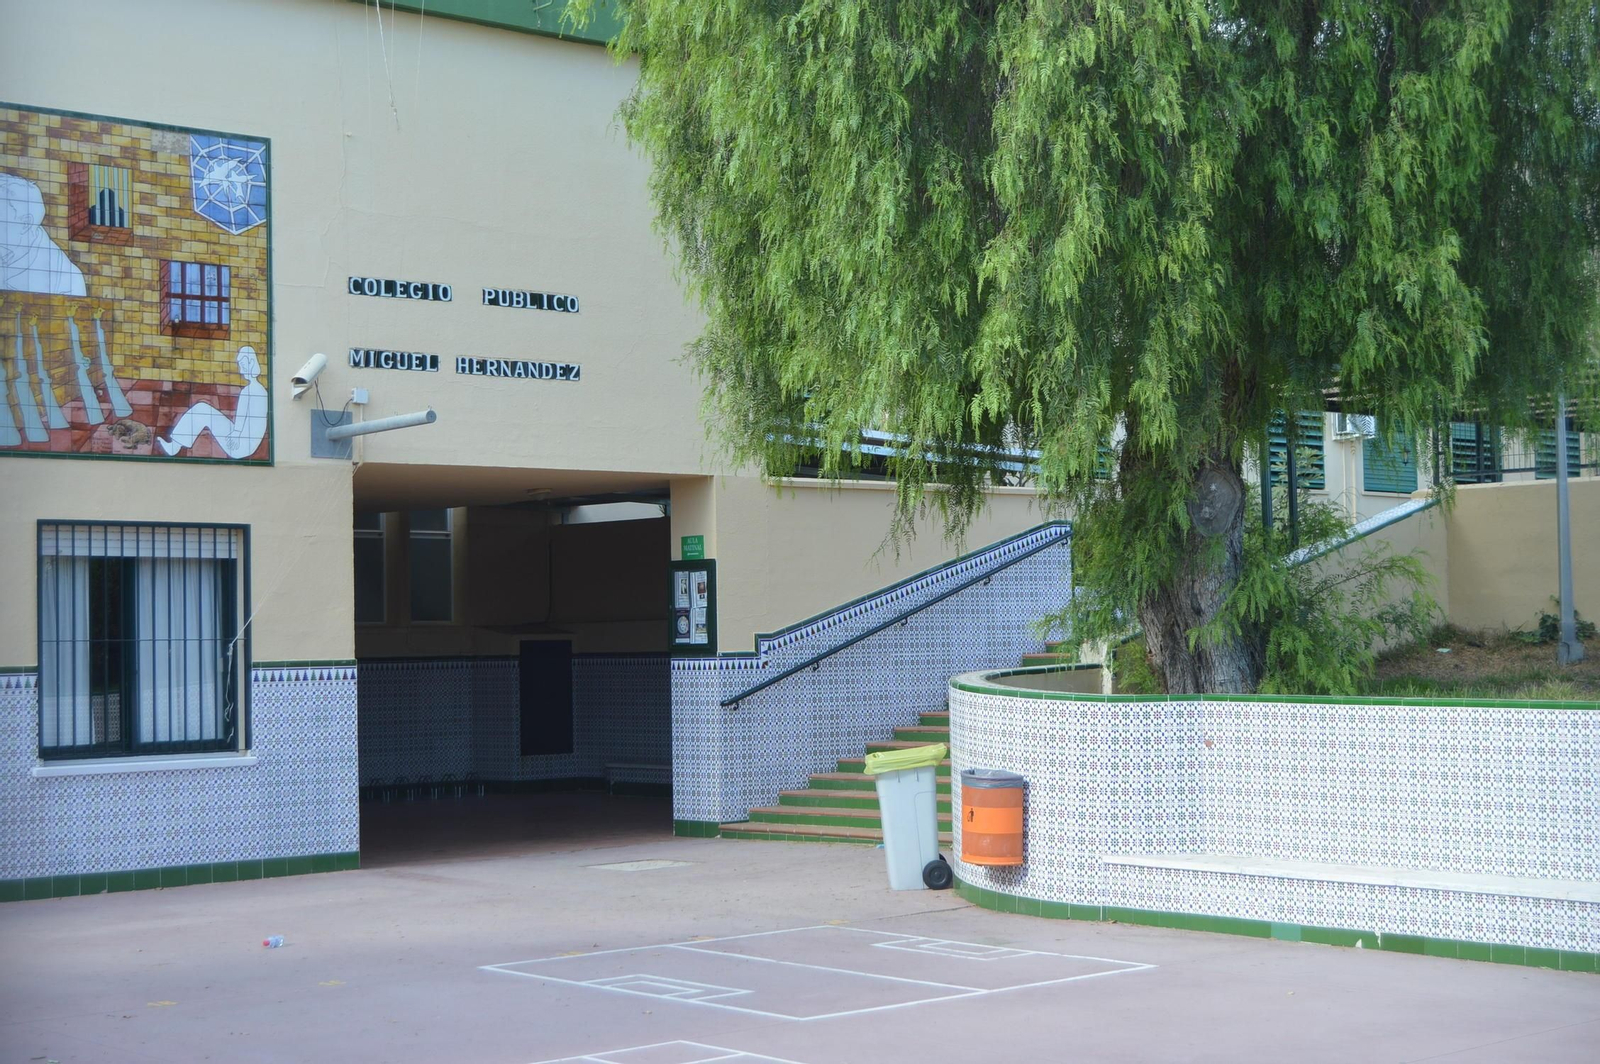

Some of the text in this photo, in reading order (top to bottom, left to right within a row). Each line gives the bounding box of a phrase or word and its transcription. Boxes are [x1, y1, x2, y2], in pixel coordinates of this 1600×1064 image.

[349, 277, 579, 313] COLEGIO PUBLICO
[350, 349, 580, 381] MIGUEL HERNANDEZ
